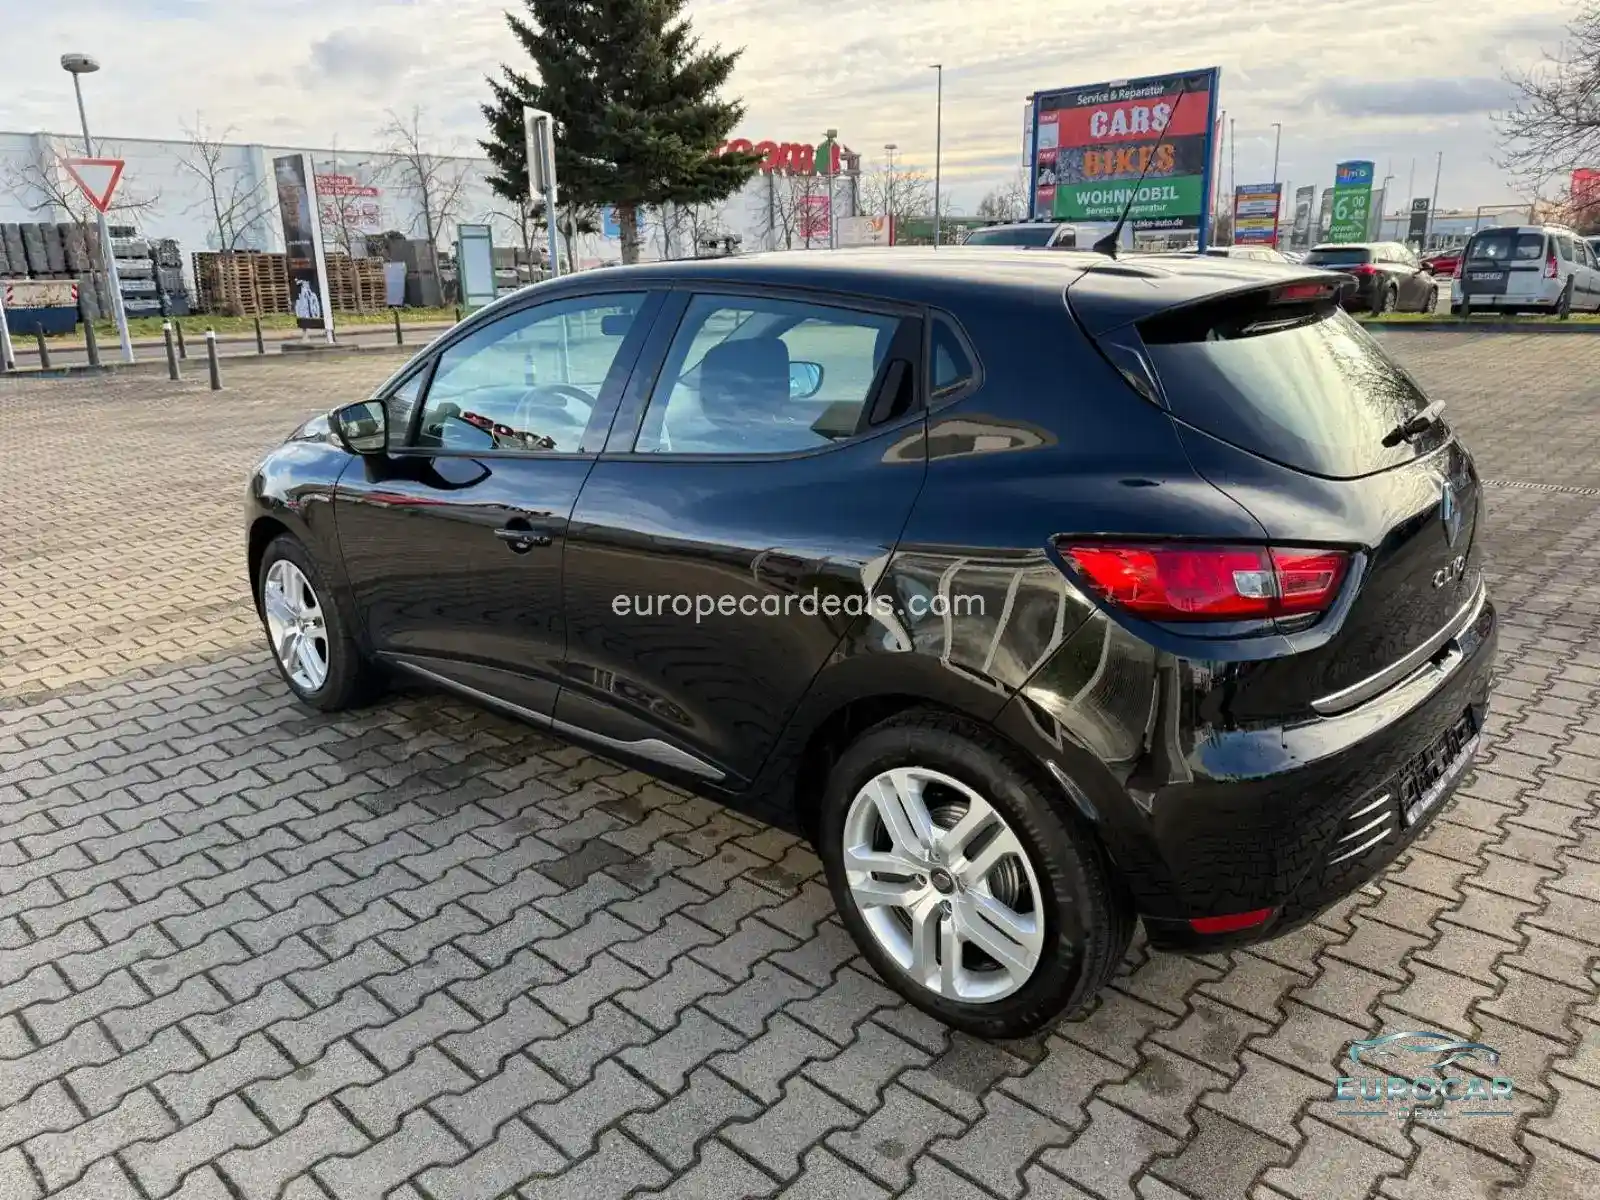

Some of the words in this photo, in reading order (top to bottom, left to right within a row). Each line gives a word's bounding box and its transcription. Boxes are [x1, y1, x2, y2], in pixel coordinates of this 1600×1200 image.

[1077, 92, 1109, 105] Service
[1110, 90, 1118, 101] &
[1119, 85, 1164, 100] Reparatur
[1090, 102, 1171, 138] CARS
[1084, 144, 1175, 177] BIKES
[1076, 186, 1179, 205] WOHNMOBIL
[1085, 205, 1115, 216] Service
